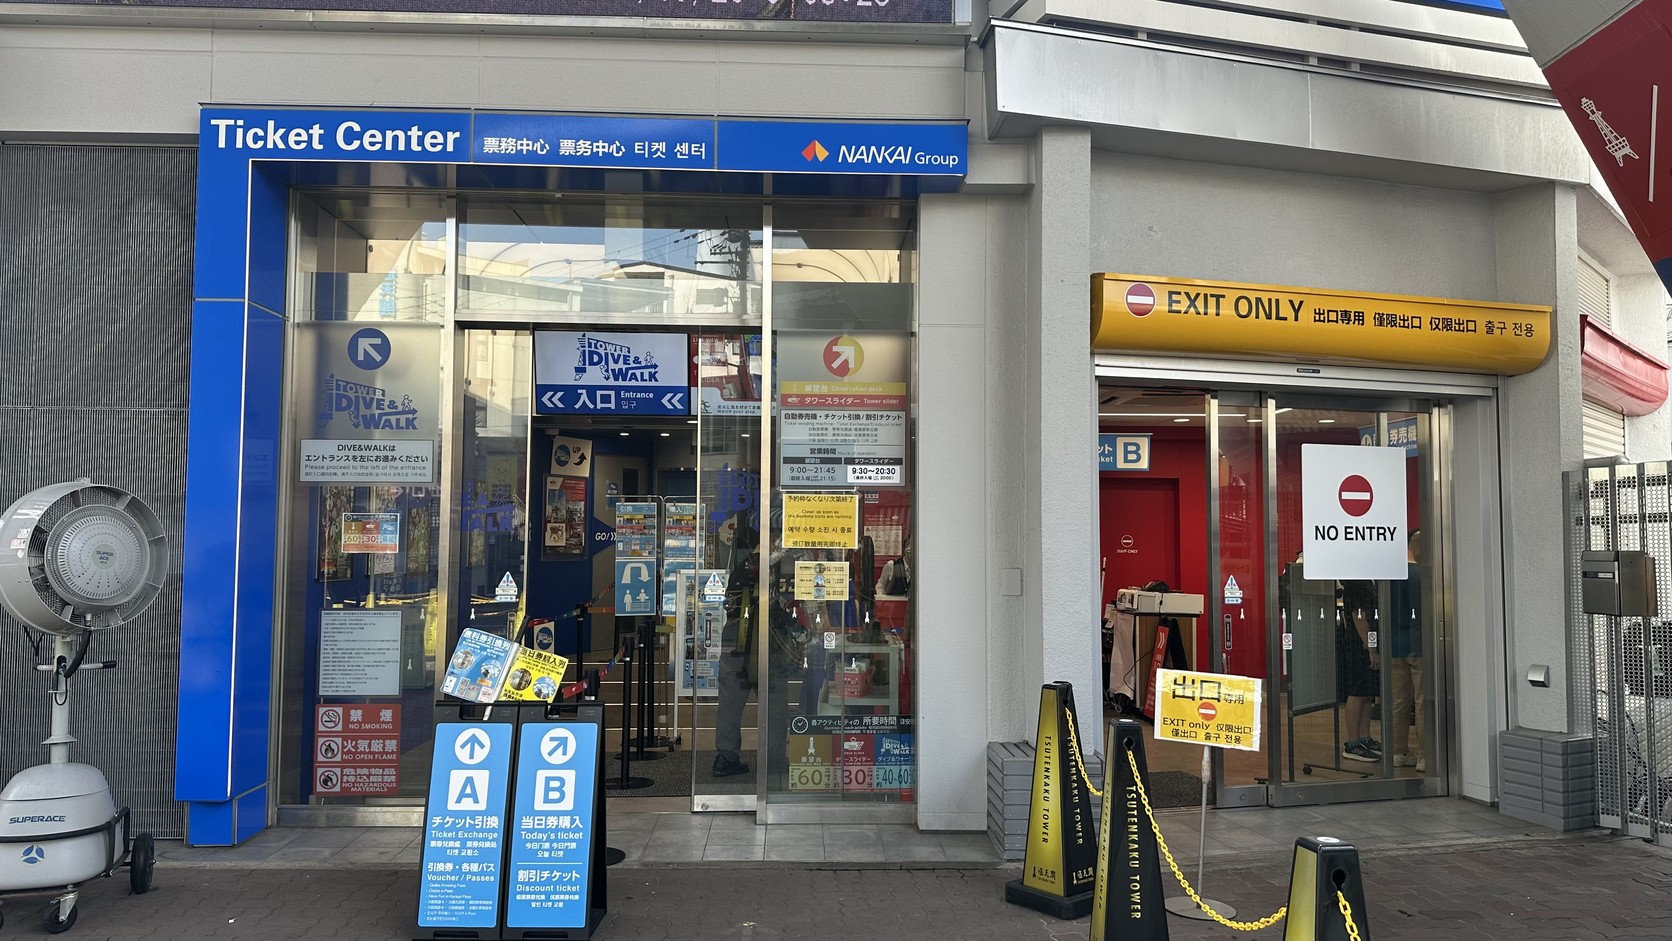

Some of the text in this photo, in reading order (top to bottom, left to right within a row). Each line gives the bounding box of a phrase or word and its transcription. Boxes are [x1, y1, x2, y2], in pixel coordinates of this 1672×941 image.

[210, 119, 460, 152] Ticket Center
[483, 138, 626, 156] 票務中心 票务中心
[634, 141, 706, 160] 티켓 센터
[838, 145, 959, 168] NANKAI Group
[1167, 290, 1304, 322] EXIT ONLY
[1313, 308, 1365, 326] 出口専用
[1373, 312, 1477, 334] 僅限出口 仅限出口
[1484, 320, 1534, 338] 출구 전용
[588, 339, 630, 354] TOWER
[588, 350, 642, 367] DIVE &
[610, 368, 659, 382] WALK
[338, 381, 385, 398] TOWER
[620, 390, 654, 398] Entrance
[334, 393, 398, 414] DIVE &
[574, 389, 616, 410] 入口
[620, 400, 637, 408] 입구
[362, 412, 418, 430] WALK
[305, 454, 428, 462] エントランスを左にお進みください
[1124, 442, 1142, 464] B
[1314, 525, 1398, 542] NO ENTRY
[1162, 718, 1210, 730] EXIT only
[1216, 723, 1252, 734] 仅限出口
[343, 740, 397, 752] 火気厳禁
[1204, 732, 1242, 744] 출구 전용
[798, 770, 822, 786] 60
[844, 769, 866, 785] 30
[454, 776, 480, 804] A
[542, 776, 566, 804] B
[1042, 736, 1052, 844] TSUTENKAKU TOWER
[8, 815, 66, 824] SUPERACE
[432, 816, 498, 828] チケット引換
[520, 816, 584, 829] 当日券購入
[1074, 808, 1083, 844] TOWER
[458, 831, 498, 840] Exchange
[521, 831, 583, 841] Today's ticket
[1126, 785, 1141, 919] TSUTENKAKU TOWER
[517, 870, 580, 882] 割引チケット
